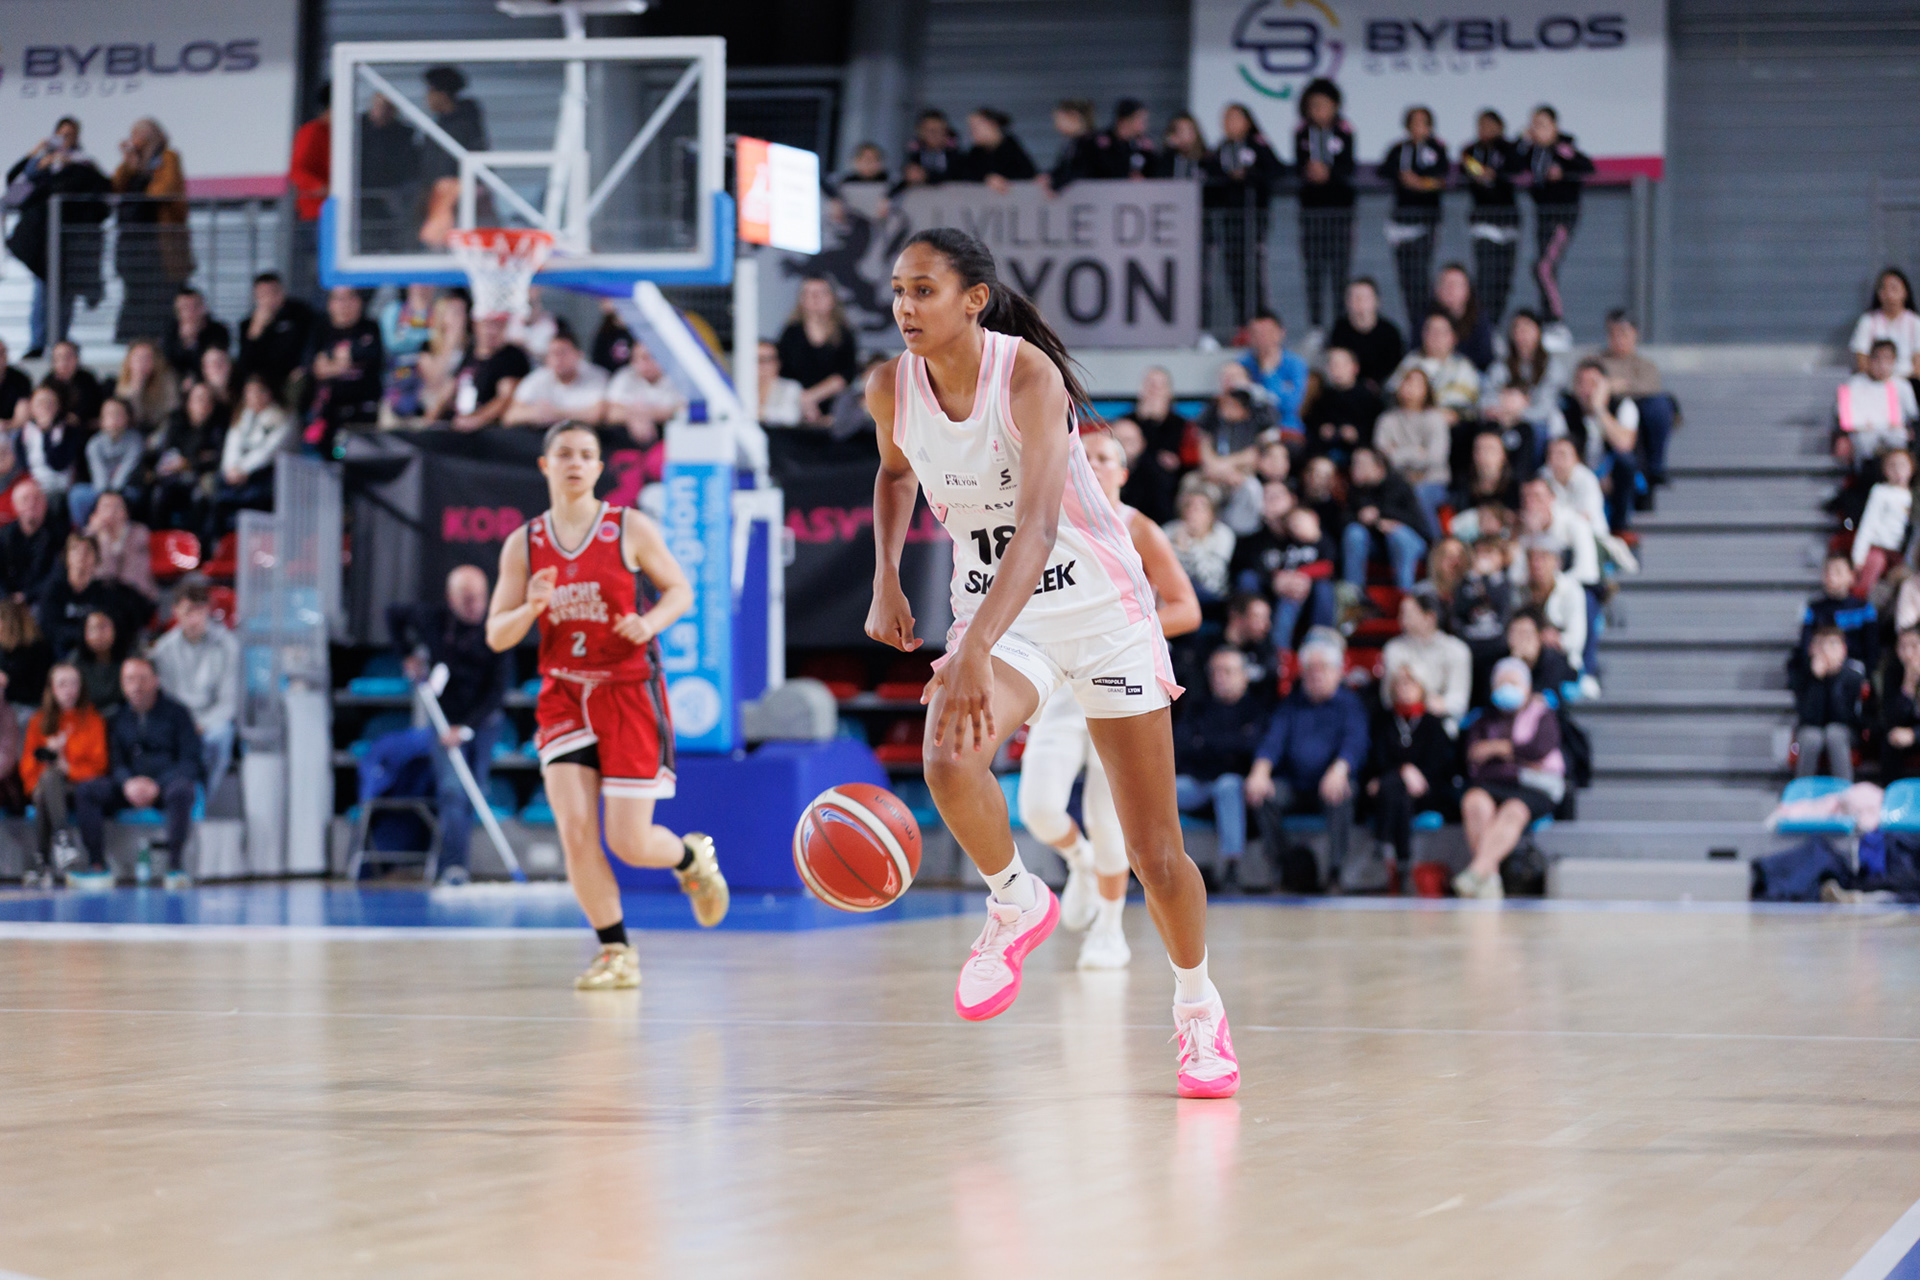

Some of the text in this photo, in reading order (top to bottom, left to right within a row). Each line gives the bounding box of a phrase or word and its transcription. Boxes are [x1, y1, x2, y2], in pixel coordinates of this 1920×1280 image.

[1364, 15, 1627, 53] BYBLOS
[23, 39, 260, 78] BYBLOS
[960, 203, 1179, 248] VILLE DE
[1009, 257, 1177, 326] YON
[984, 500, 1014, 511] ASV
[571, 631, 587, 657] 2
